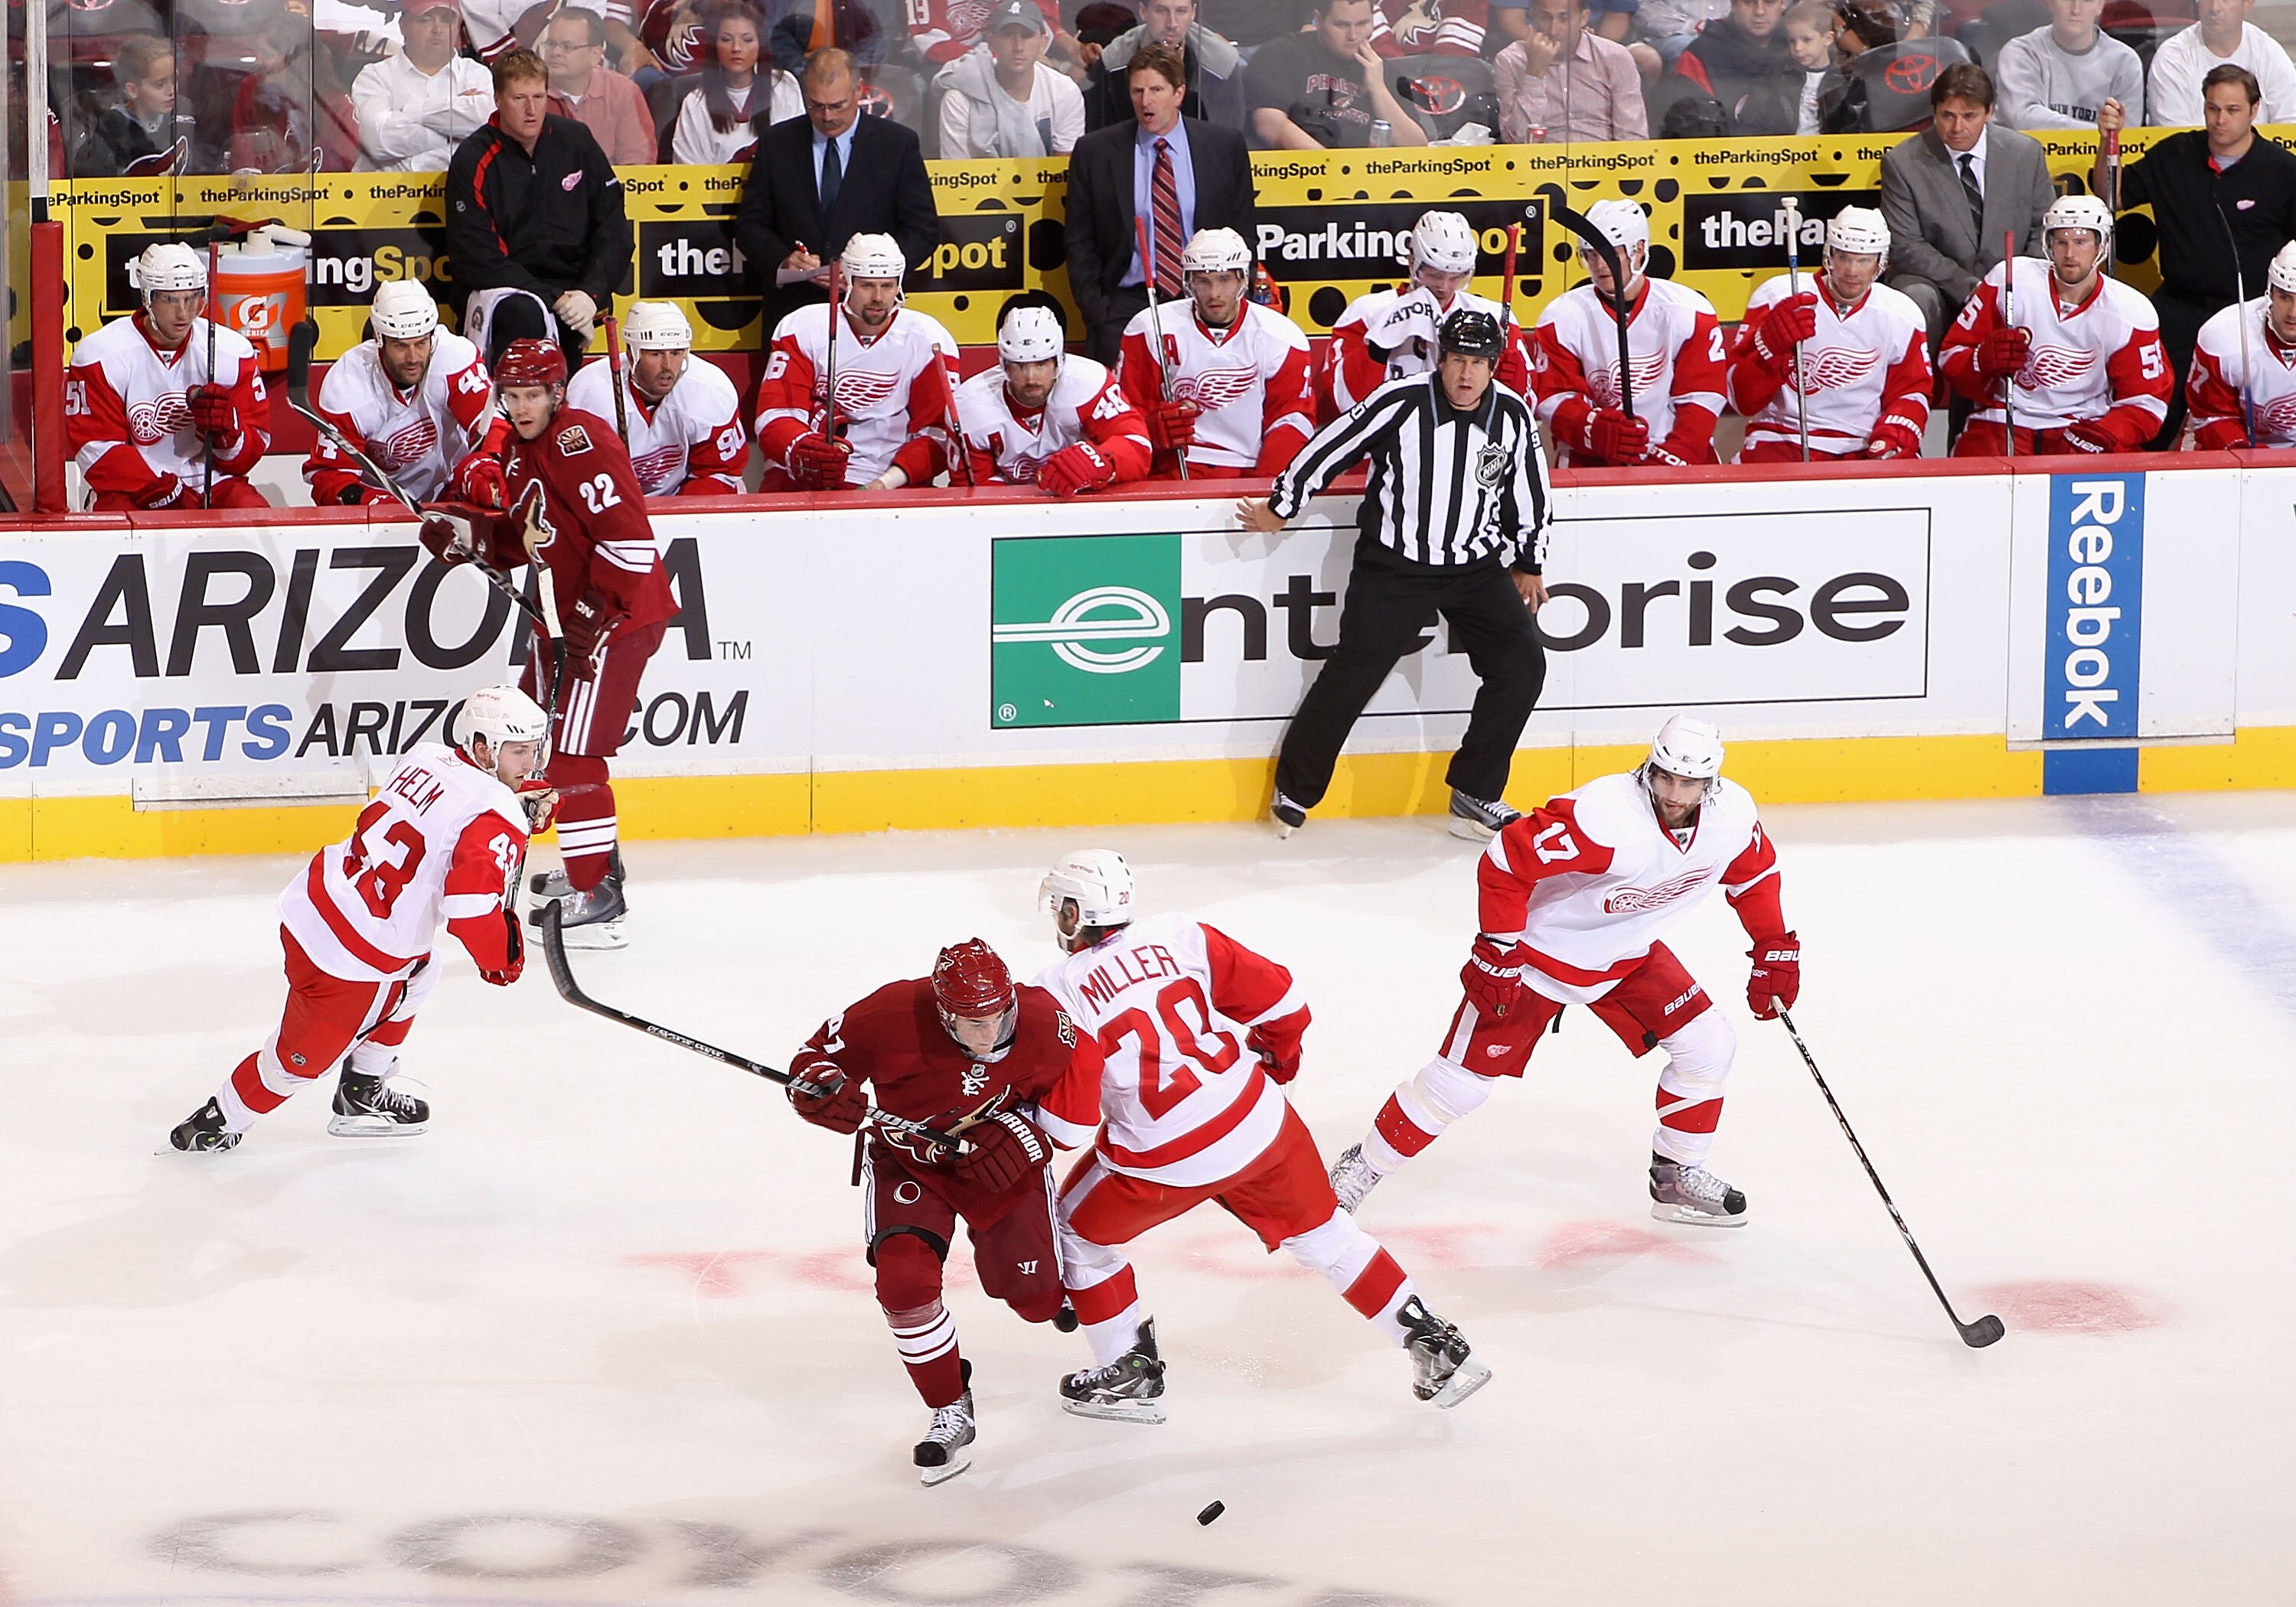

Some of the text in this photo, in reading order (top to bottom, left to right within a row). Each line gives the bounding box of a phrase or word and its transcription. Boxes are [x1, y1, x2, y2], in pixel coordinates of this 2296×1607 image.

[65, 380, 91, 416] 51
[579, 473, 621, 514] 22
[2065, 481, 2125, 729] Reebok
[386, 765, 445, 817] HELM
[1532, 821, 1581, 865] 17
[1078, 944, 1181, 1016] MILLER
[1097, 977, 1241, 1122] 20
[995, 1111, 1045, 1164] ARRIOR
